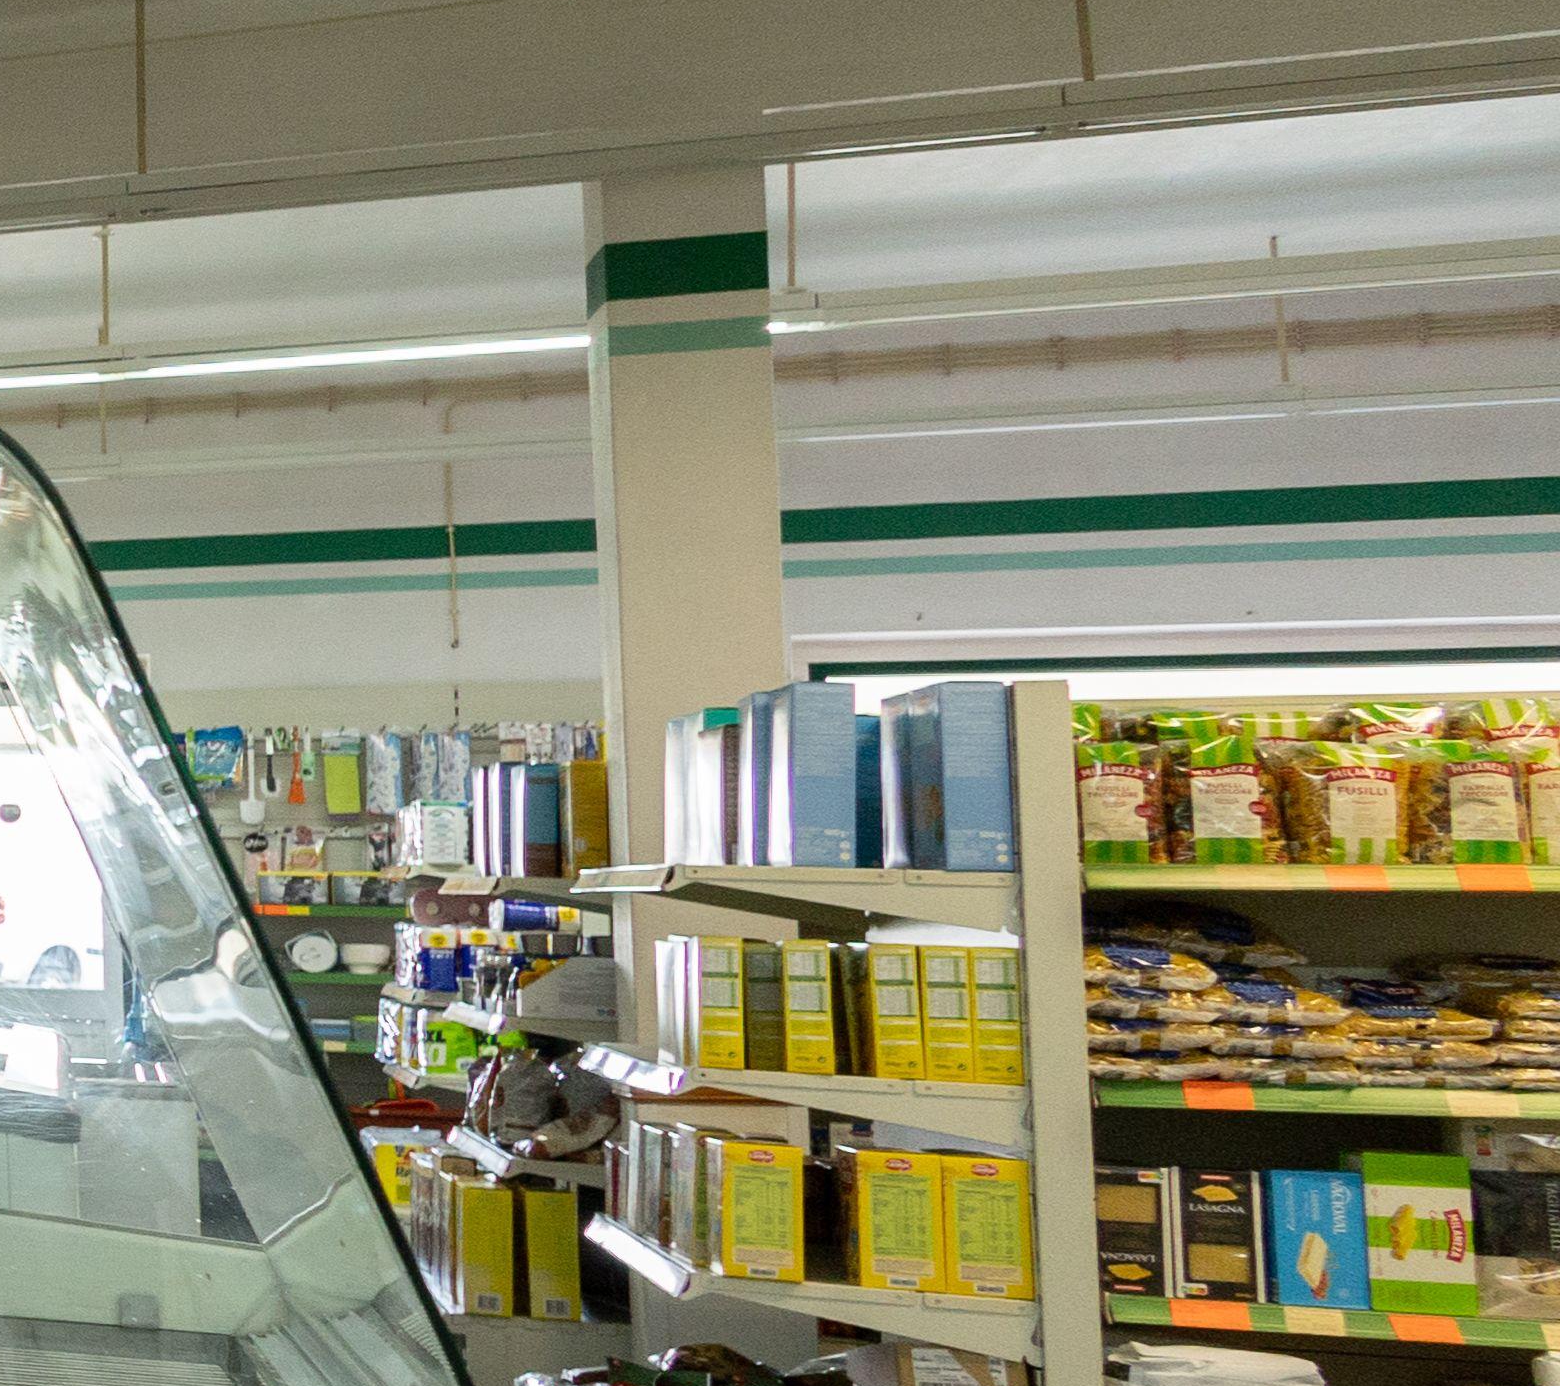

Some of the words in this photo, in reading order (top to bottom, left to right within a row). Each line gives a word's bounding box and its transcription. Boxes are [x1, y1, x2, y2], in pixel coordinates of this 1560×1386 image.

[1337, 786, 1388, 797] FUSILLI
[1189, 1202, 1246, 1214] LASAGNA
[1447, 1212, 1465, 1259] MILANEZA
